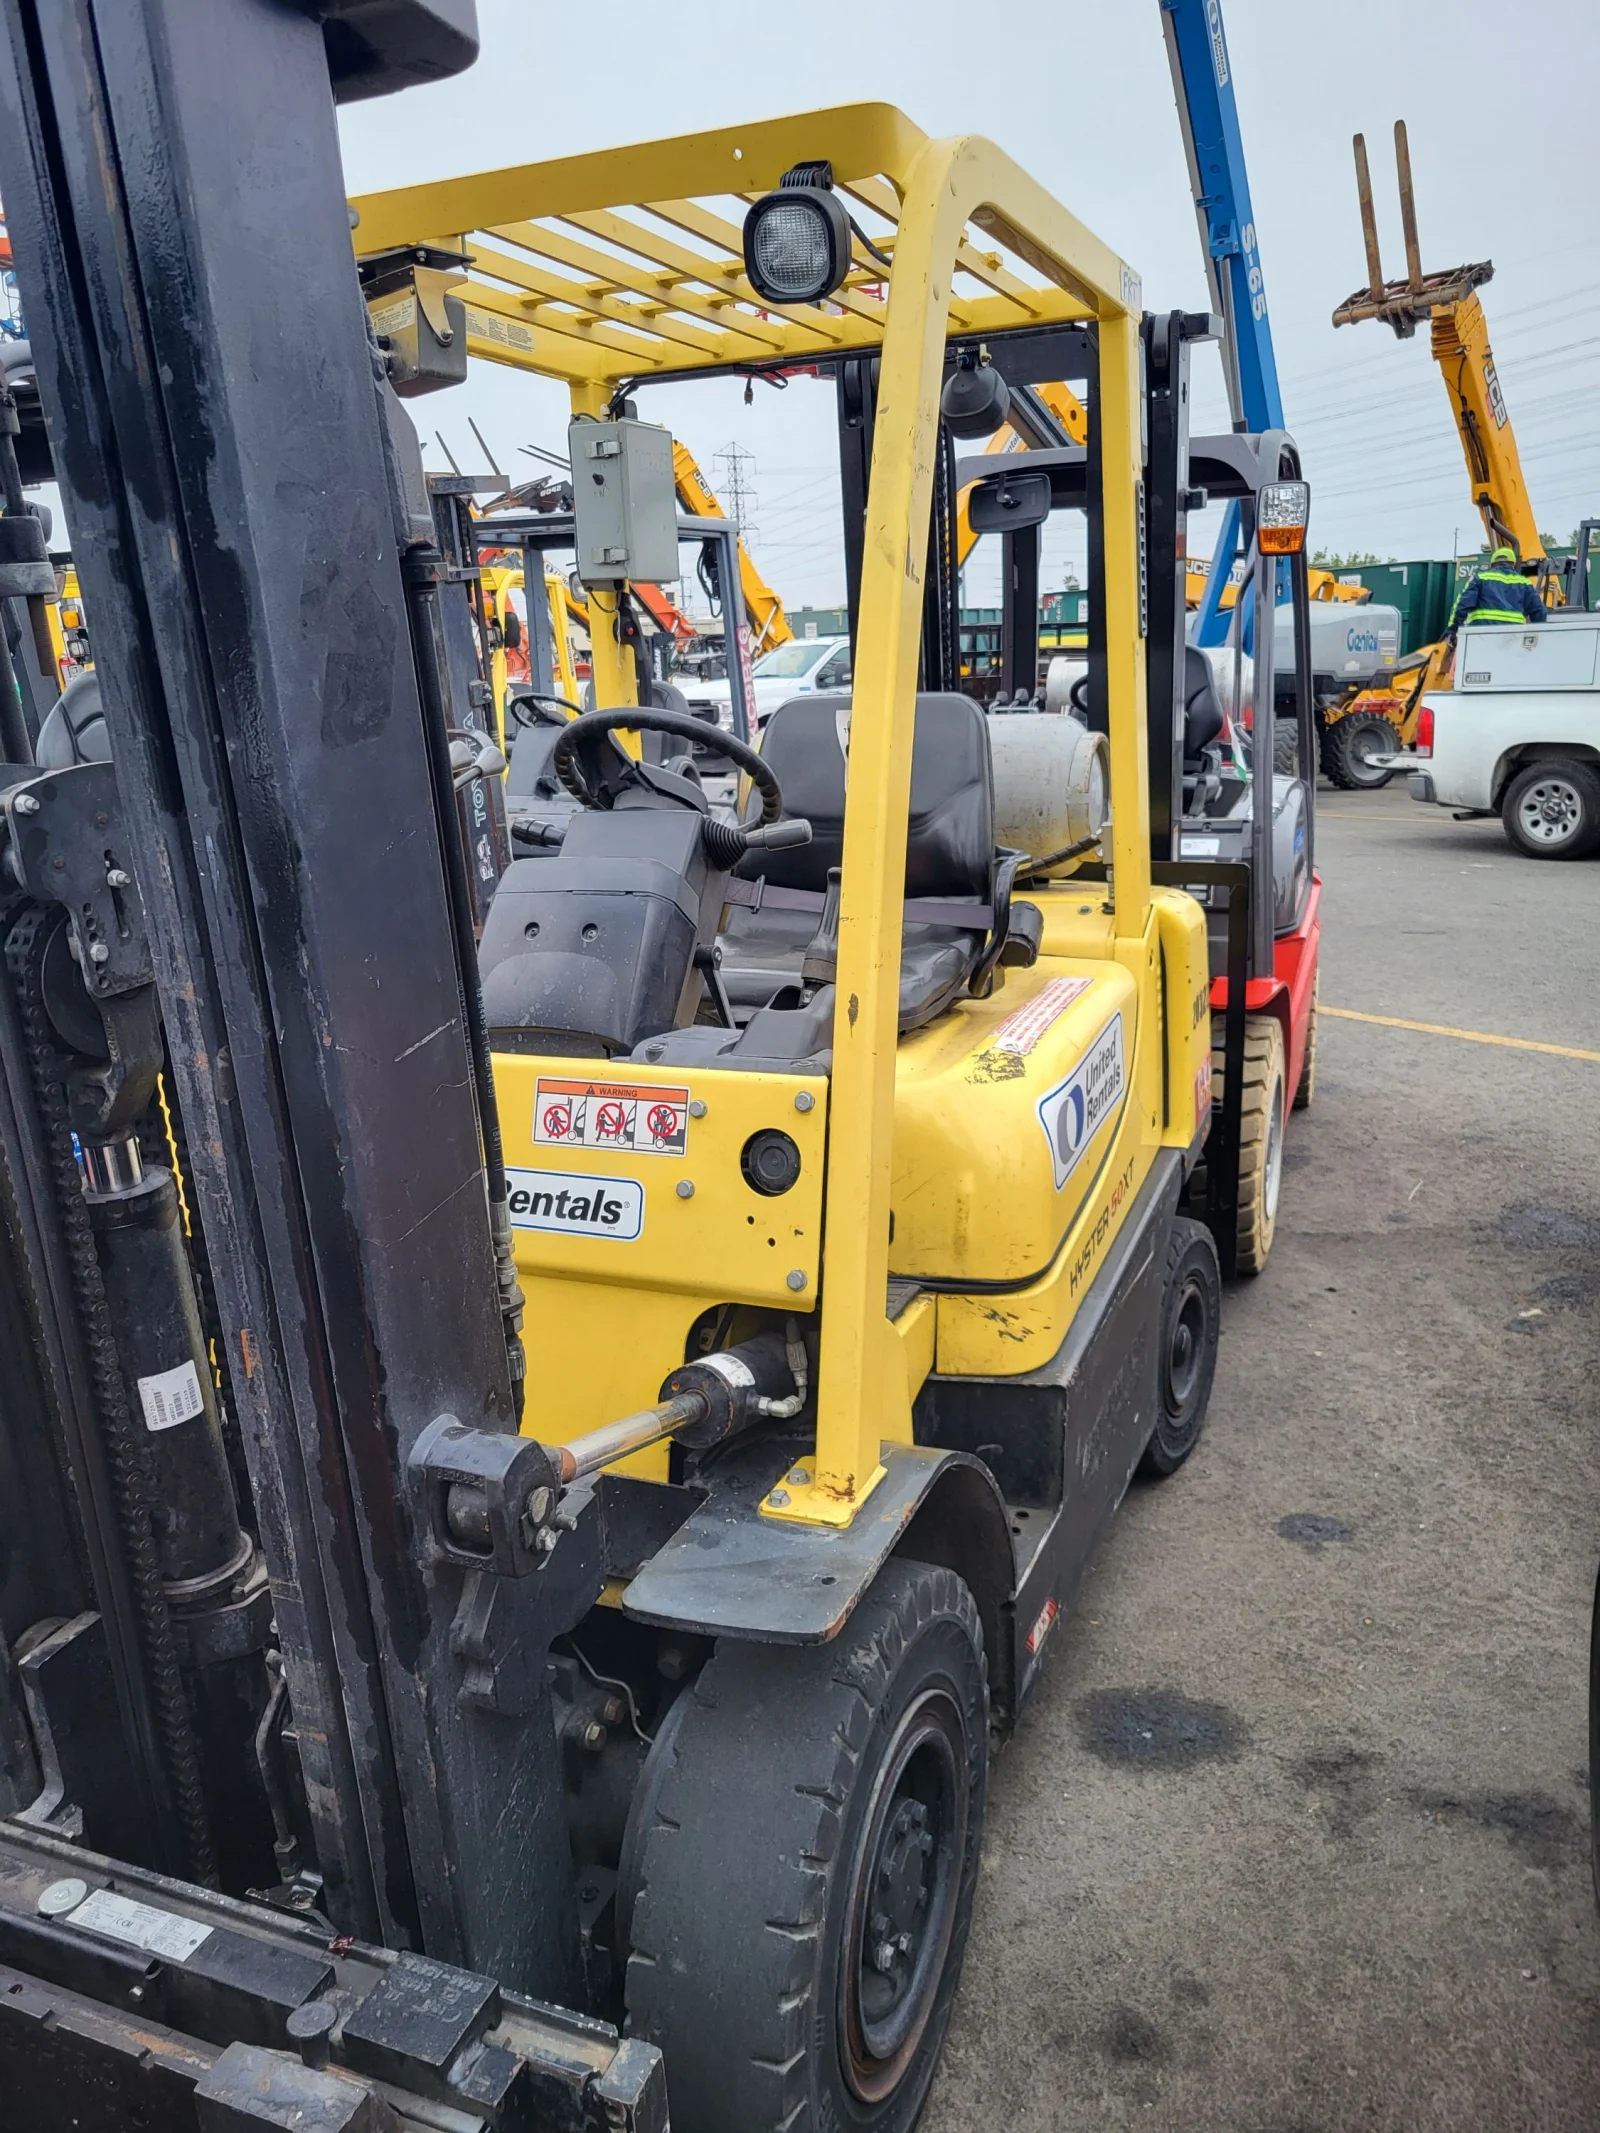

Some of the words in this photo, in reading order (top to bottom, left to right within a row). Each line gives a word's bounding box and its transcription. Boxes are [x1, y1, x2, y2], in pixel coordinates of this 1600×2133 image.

[1241, 222, 1266, 321] S-65
[1482, 359, 1508, 430] JCB
[692, 468, 713, 500] JCB
[1347, 628, 1375, 652] Genie
[599, 1087, 638, 1098] WARNING
[1086, 1041, 1117, 1096] United
[1086, 1064, 1121, 1129] Rentals
[1070, 1205, 1109, 1297] HYSTER
